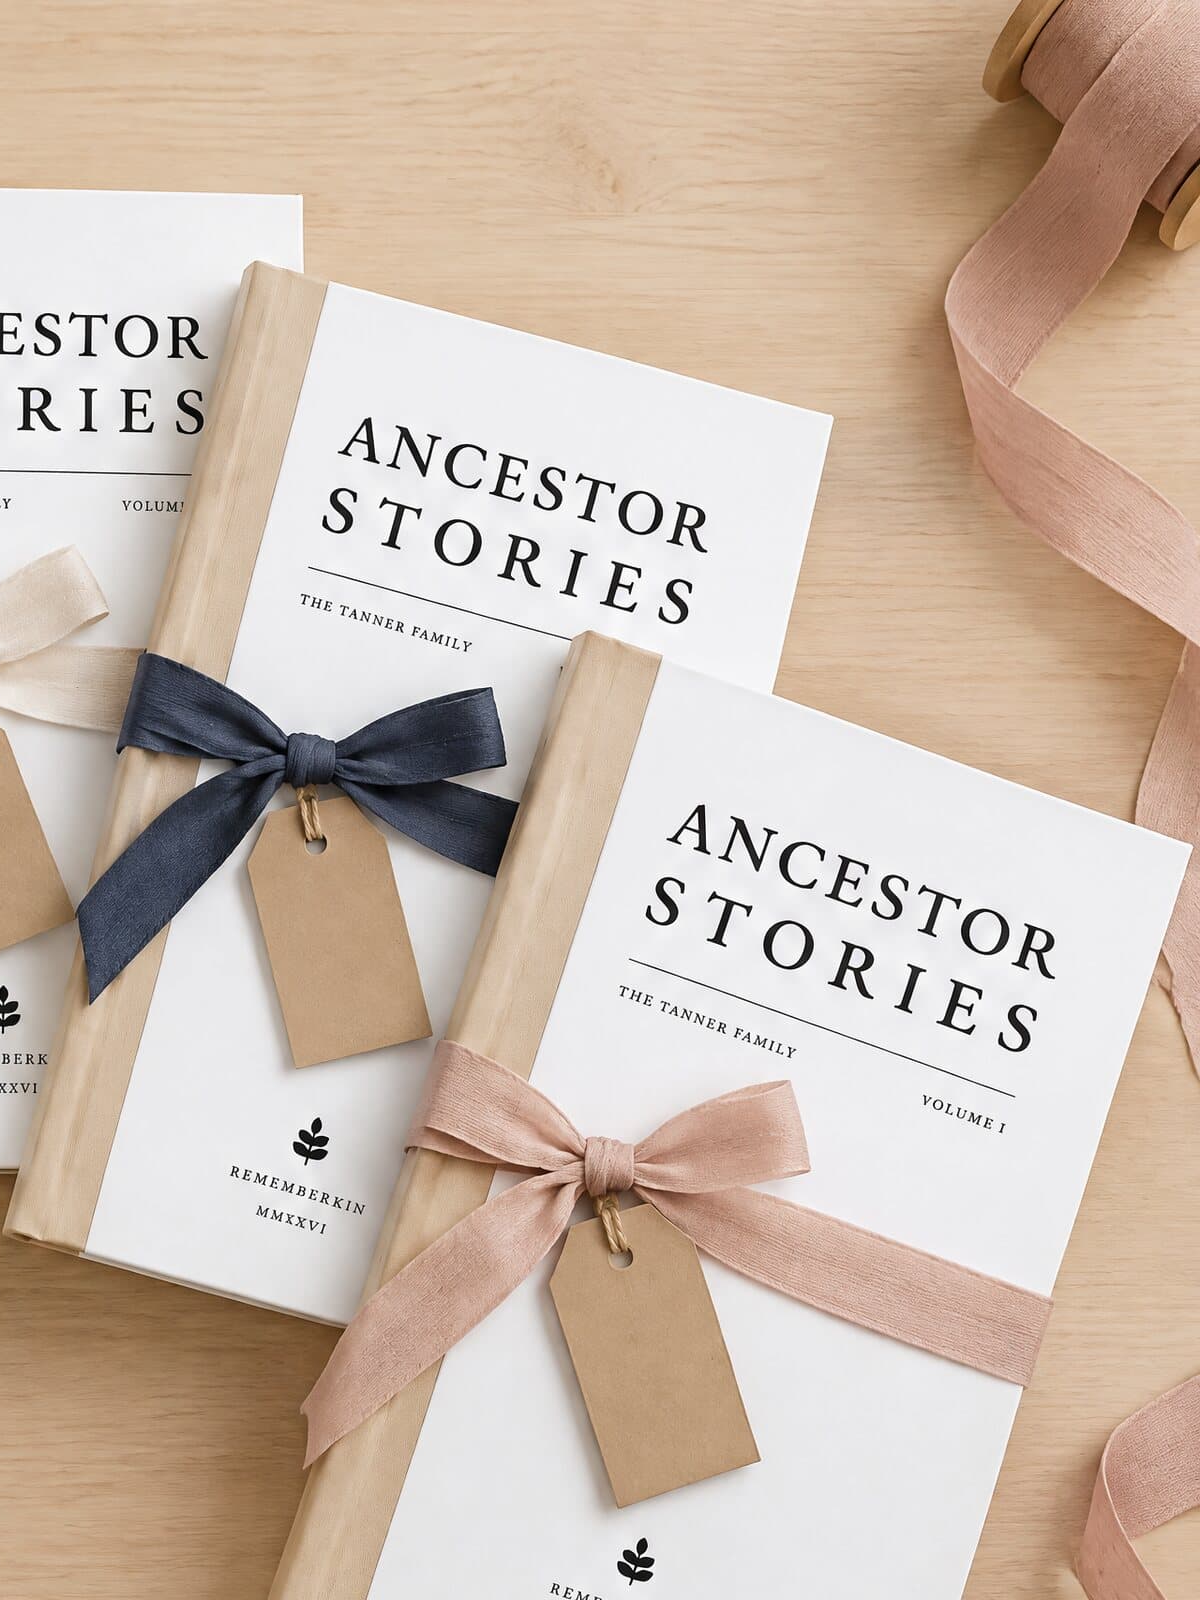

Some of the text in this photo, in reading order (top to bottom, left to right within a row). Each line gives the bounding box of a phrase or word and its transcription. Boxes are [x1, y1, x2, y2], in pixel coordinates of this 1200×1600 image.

[337, 417, 708, 553] ANCESTOR
[322, 488, 692, 624] STORIES
[300, 593, 473, 653] THE TANNER FAMILY
[666, 804, 1055, 980] ANCESTOR
[645, 877, 1037, 1052] STORIES
[619, 984, 798, 1059] THE TANNER FAMILY
[922, 1094, 1006, 1134] VOLUME I
[229, 1165, 366, 1216] REMEMBERKIN
[255, 1204, 327, 1235] MMXXVI
